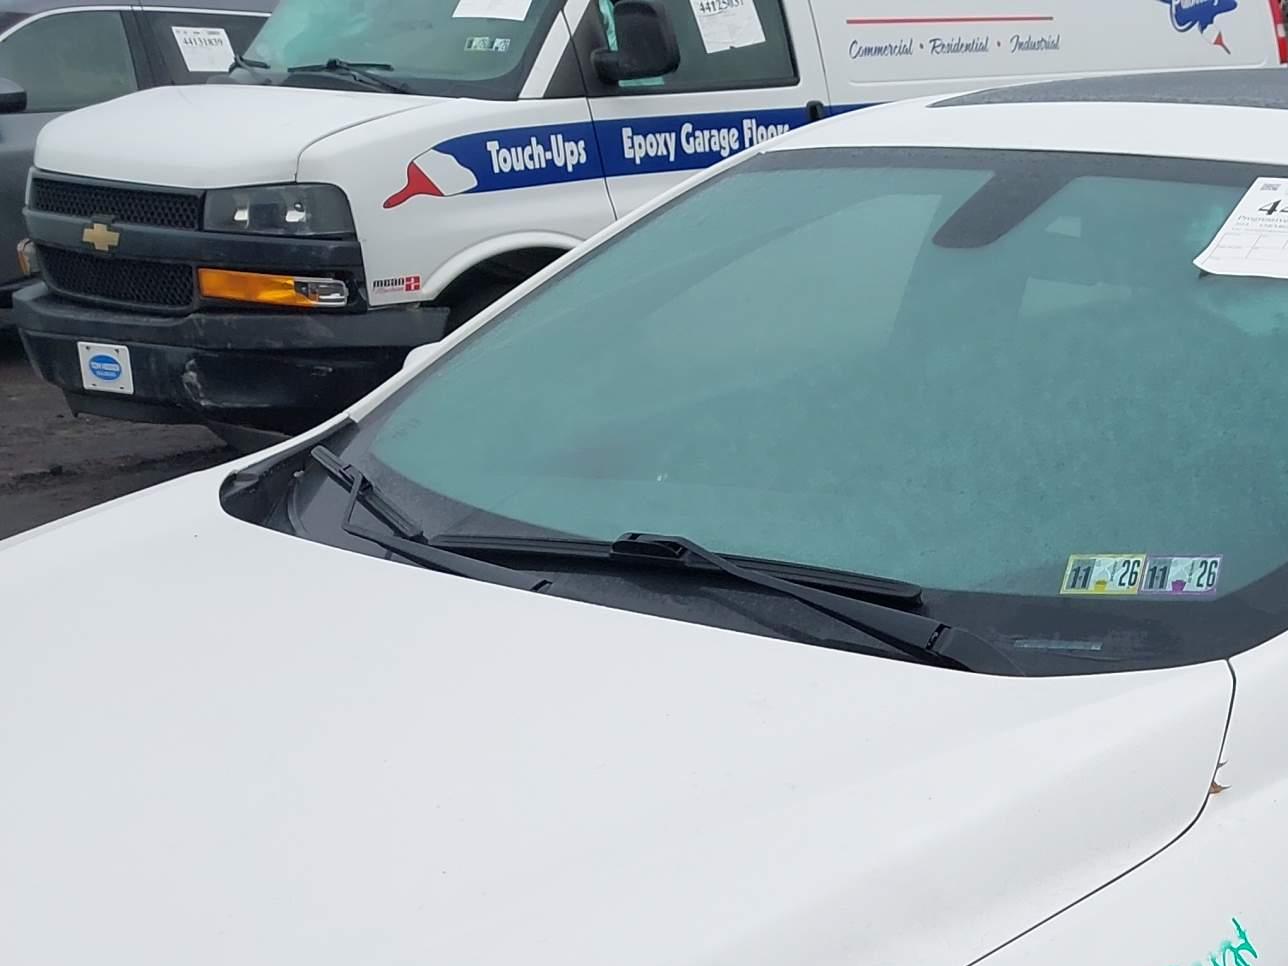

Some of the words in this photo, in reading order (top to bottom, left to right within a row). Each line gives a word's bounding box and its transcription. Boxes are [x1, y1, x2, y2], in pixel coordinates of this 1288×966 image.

[849, 38, 914, 59] Commercial
[929, 36, 989, 55] Residential
[1010, 34, 1061, 53] Industrial
[486, 133, 587, 174] Touch-Ups
[621, 127, 676, 163] Epoxy
[680, 122, 740, 158] Garage
[1070, 566, 1092, 589] 11
[1118, 559, 1141, 587] 26
[1148, 566, 1168, 589] 11
[1196, 560, 1218, 588] 26
